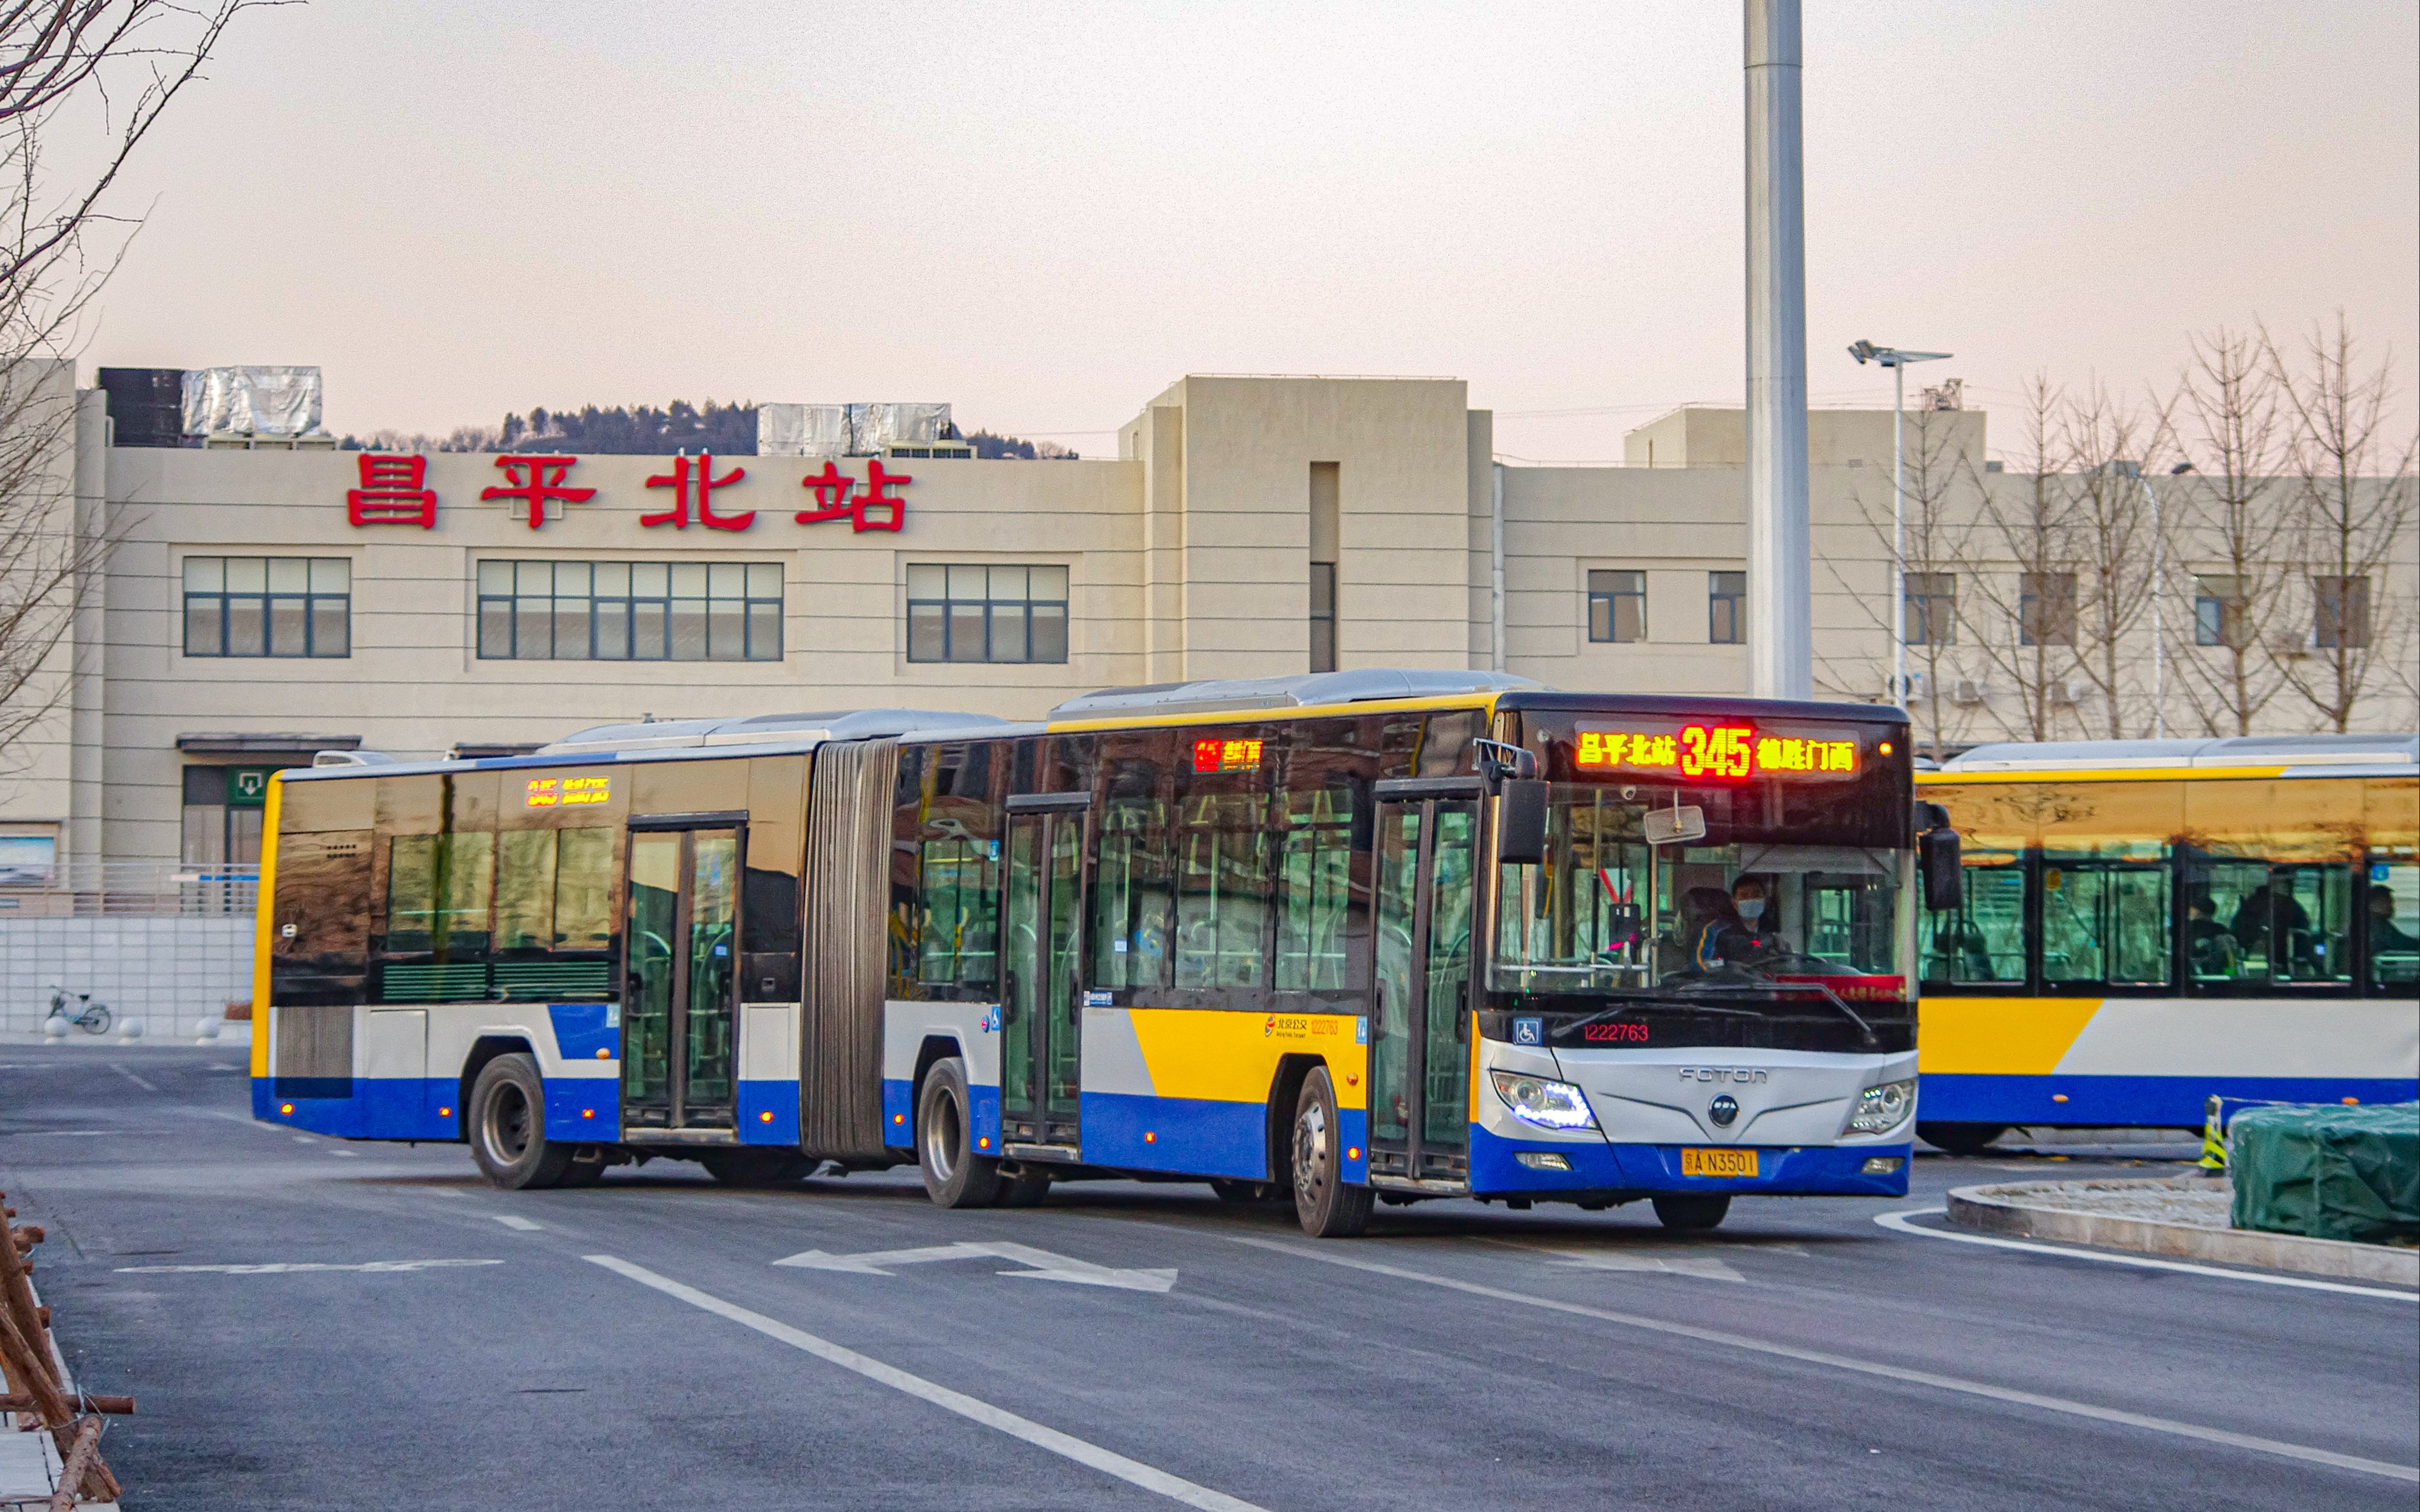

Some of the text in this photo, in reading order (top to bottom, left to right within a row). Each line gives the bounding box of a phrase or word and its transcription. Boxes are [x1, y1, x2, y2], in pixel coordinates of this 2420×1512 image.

[346, 453, 912, 532] 昌平北站
[1578, 732, 1677, 766] 昌平北站
[1681, 726, 1751, 777] 345
[1584, 1024, 1648, 1041] 1222763
[1679, 1067, 1767, 1084] FOTON
